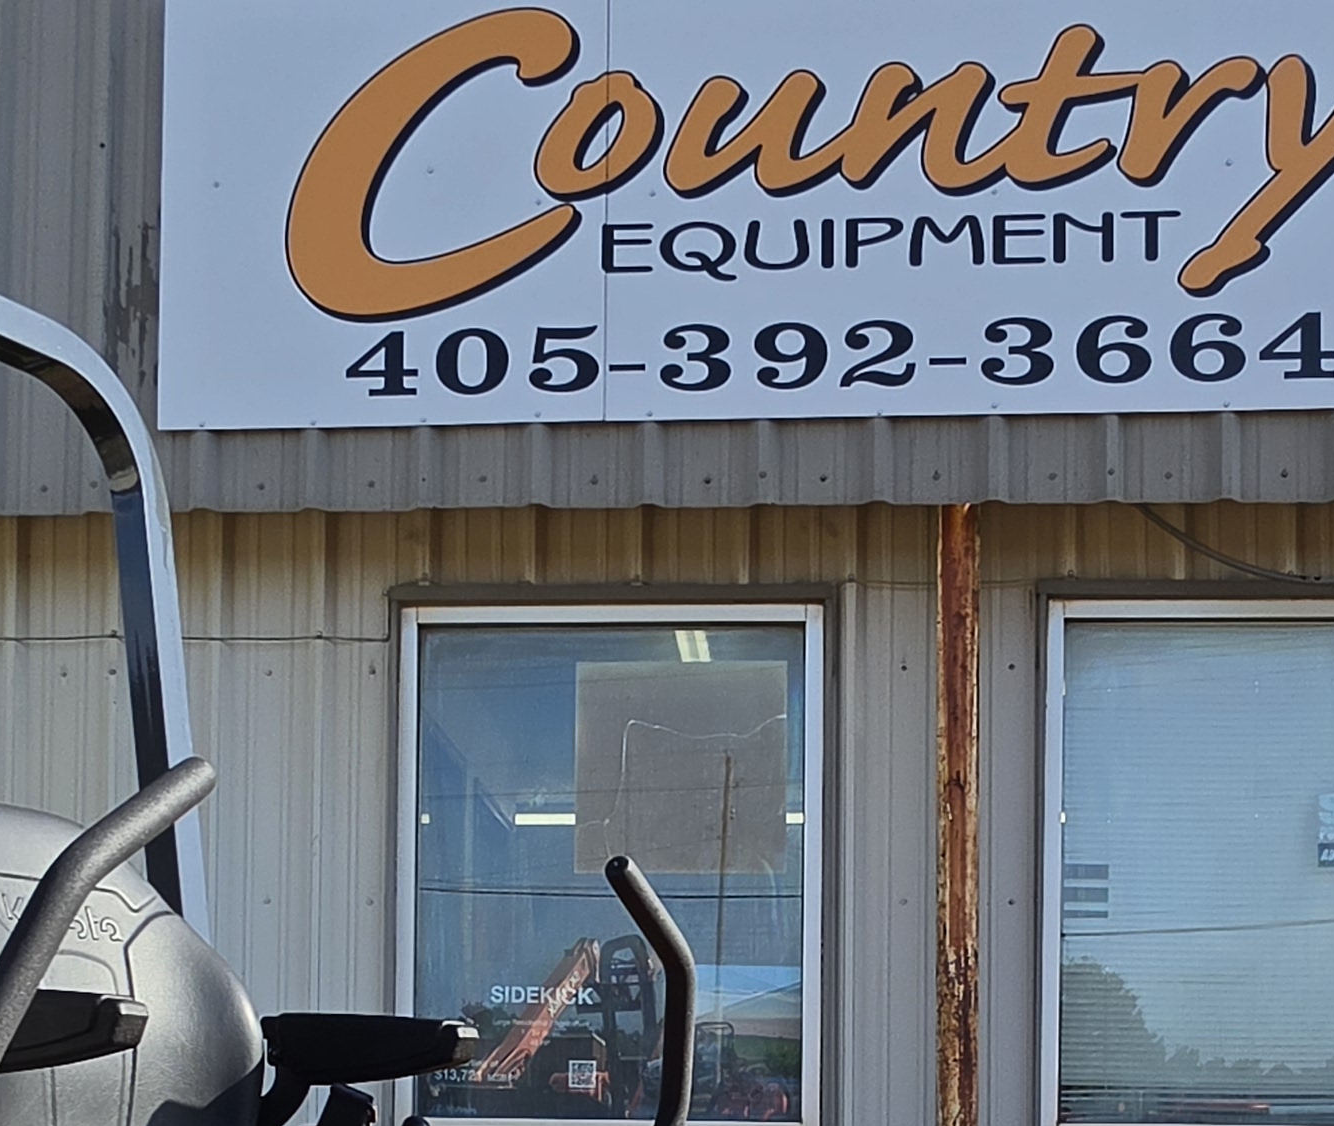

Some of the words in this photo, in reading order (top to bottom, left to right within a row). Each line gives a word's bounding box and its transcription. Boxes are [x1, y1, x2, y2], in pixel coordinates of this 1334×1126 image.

[601, 210, 1182, 282] EQUIPMENT
[1, 893, 124, 942] Kota
[490, 985, 594, 1006] SIDEKICK
